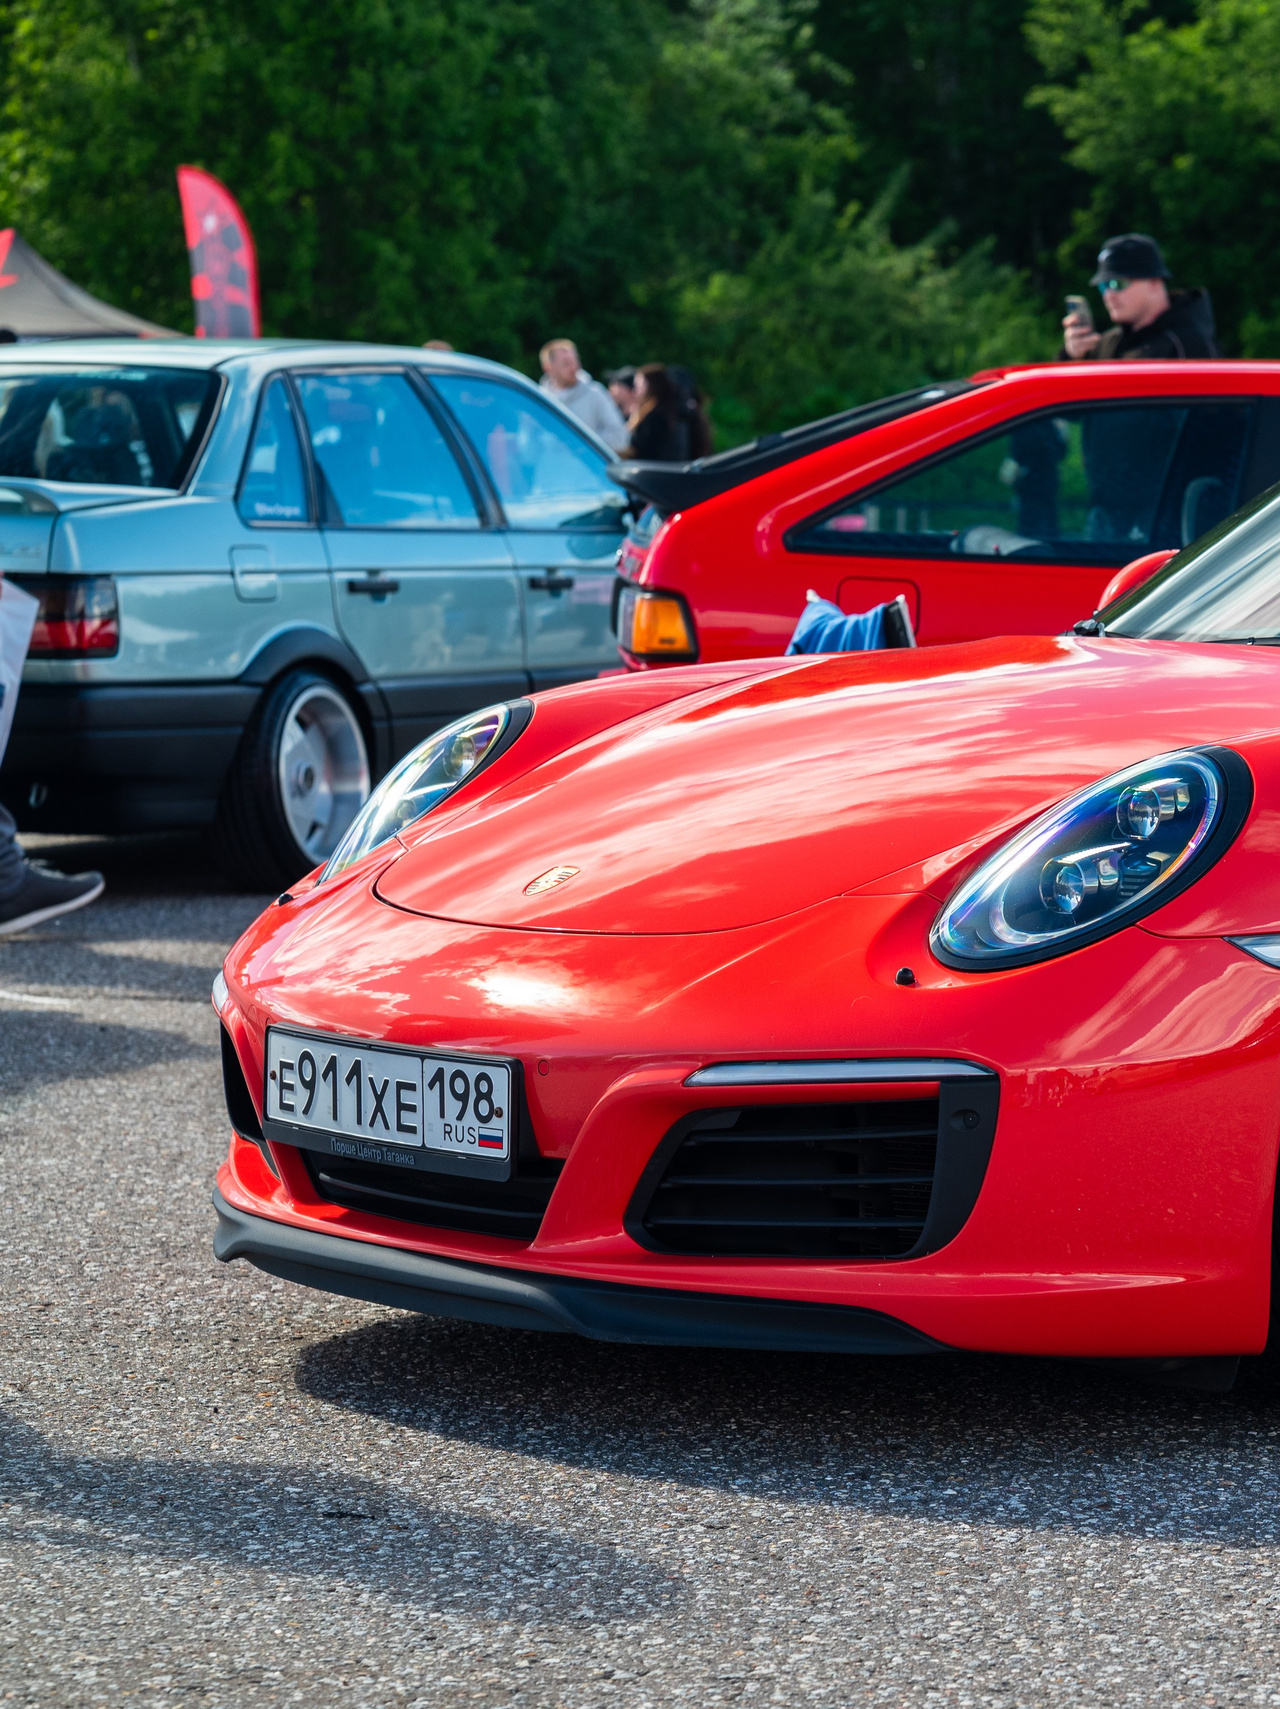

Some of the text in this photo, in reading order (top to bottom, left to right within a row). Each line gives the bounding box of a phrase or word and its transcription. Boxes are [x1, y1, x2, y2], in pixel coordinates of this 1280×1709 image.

[427, 1066, 495, 1124] 198
[443, 1122, 477, 1145] RUS
[330, 1137, 415, 1165] Порше Центр Таганка
